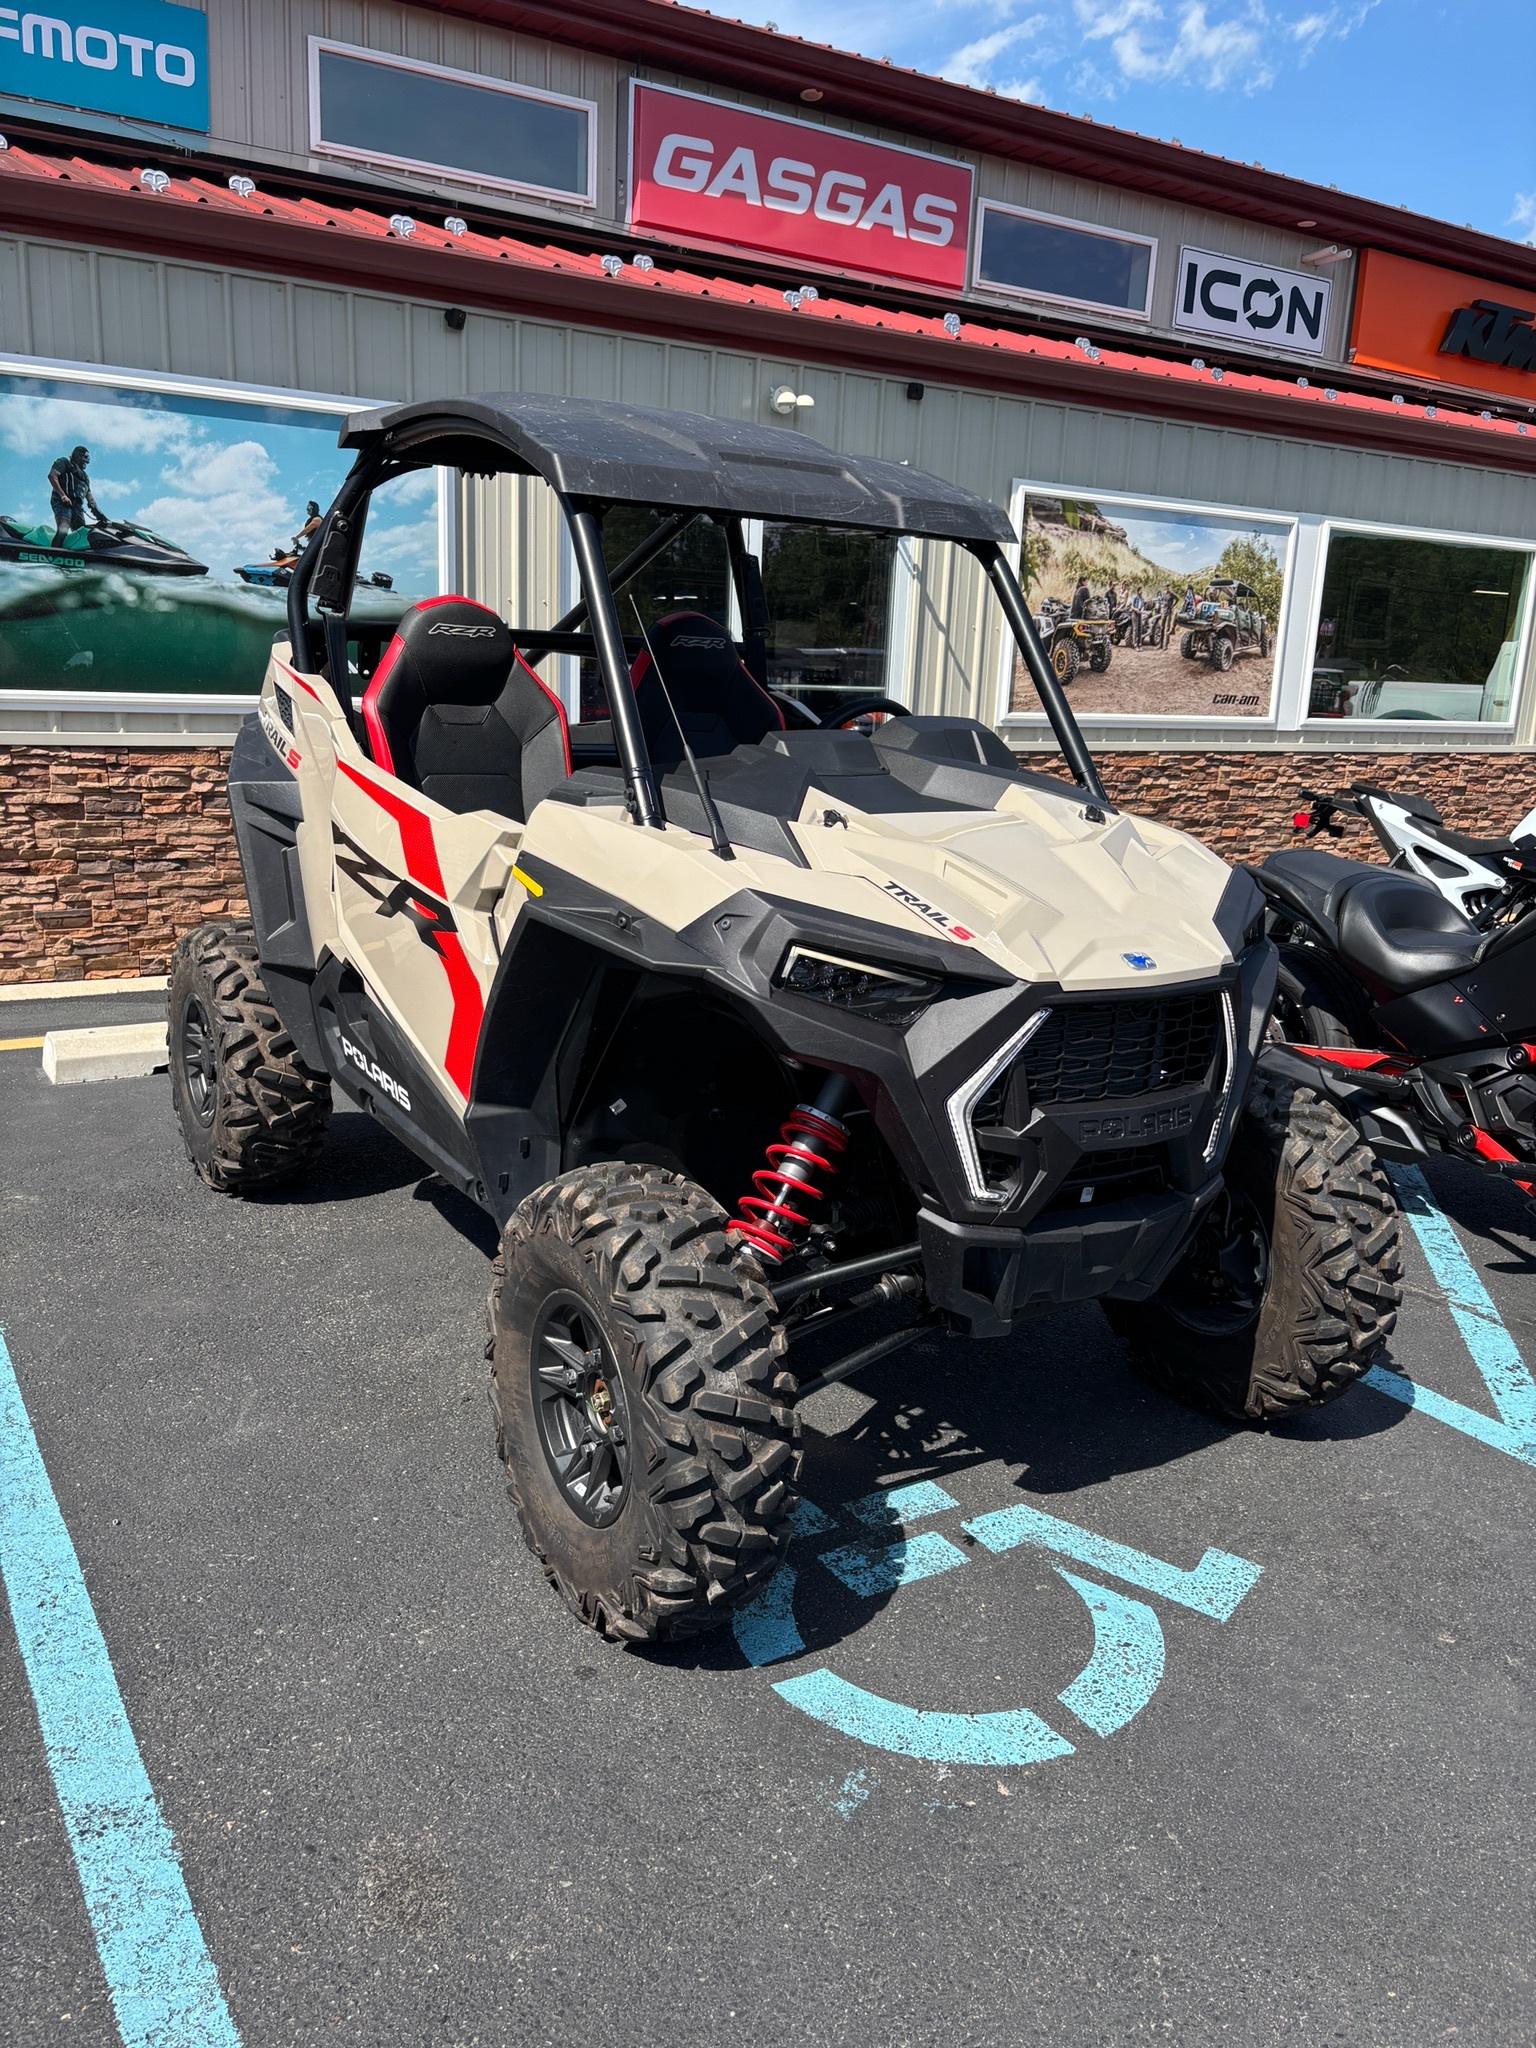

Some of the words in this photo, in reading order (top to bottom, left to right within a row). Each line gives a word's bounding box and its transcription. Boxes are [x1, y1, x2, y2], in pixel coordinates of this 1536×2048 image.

[652, 133, 958, 247] GASGAS
[1183, 262, 1324, 340] ICON
[428, 622, 496, 638] RZR
[670, 635, 727, 649] RZR
[262, 716, 287, 758] RAIL
[286, 748, 303, 770] S
[883, 880, 950, 928] TRAIL
[947, 925, 977, 941] S
[341, 1035, 412, 1112] POLARIS
[1078, 1103, 1193, 1144] POLARIS
